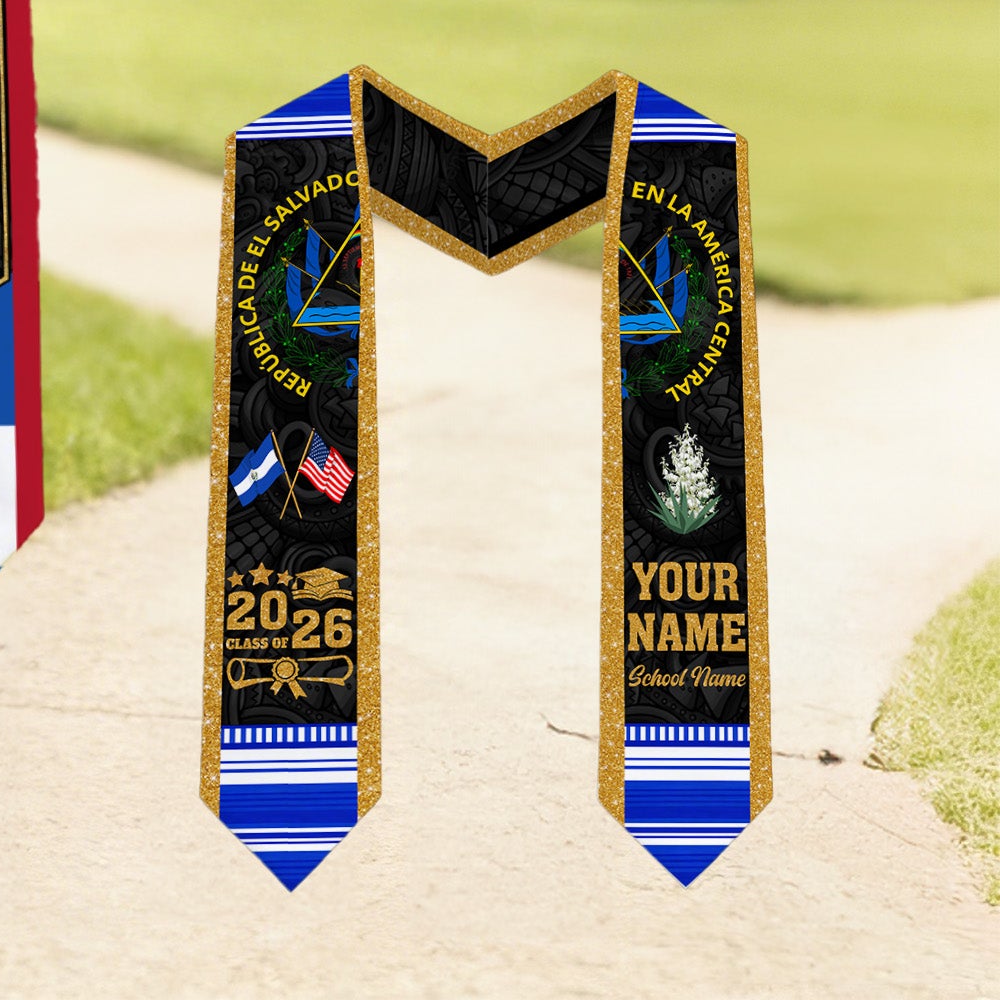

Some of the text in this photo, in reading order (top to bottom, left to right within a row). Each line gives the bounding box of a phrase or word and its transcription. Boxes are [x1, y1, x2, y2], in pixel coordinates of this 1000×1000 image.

[247, 235, 271, 258] EL
[238, 261, 259, 290] DE
[631, 181, 734, 402] EN LA AMÉRICA CENTRAL
[238, 296, 312, 397] REPÚBLICA
[632, 561, 740, 602] YOUR
[226, 637, 289, 650] CLASS OF
[627, 612, 746, 652] NAME
[628, 664, 747, 688] School Name
